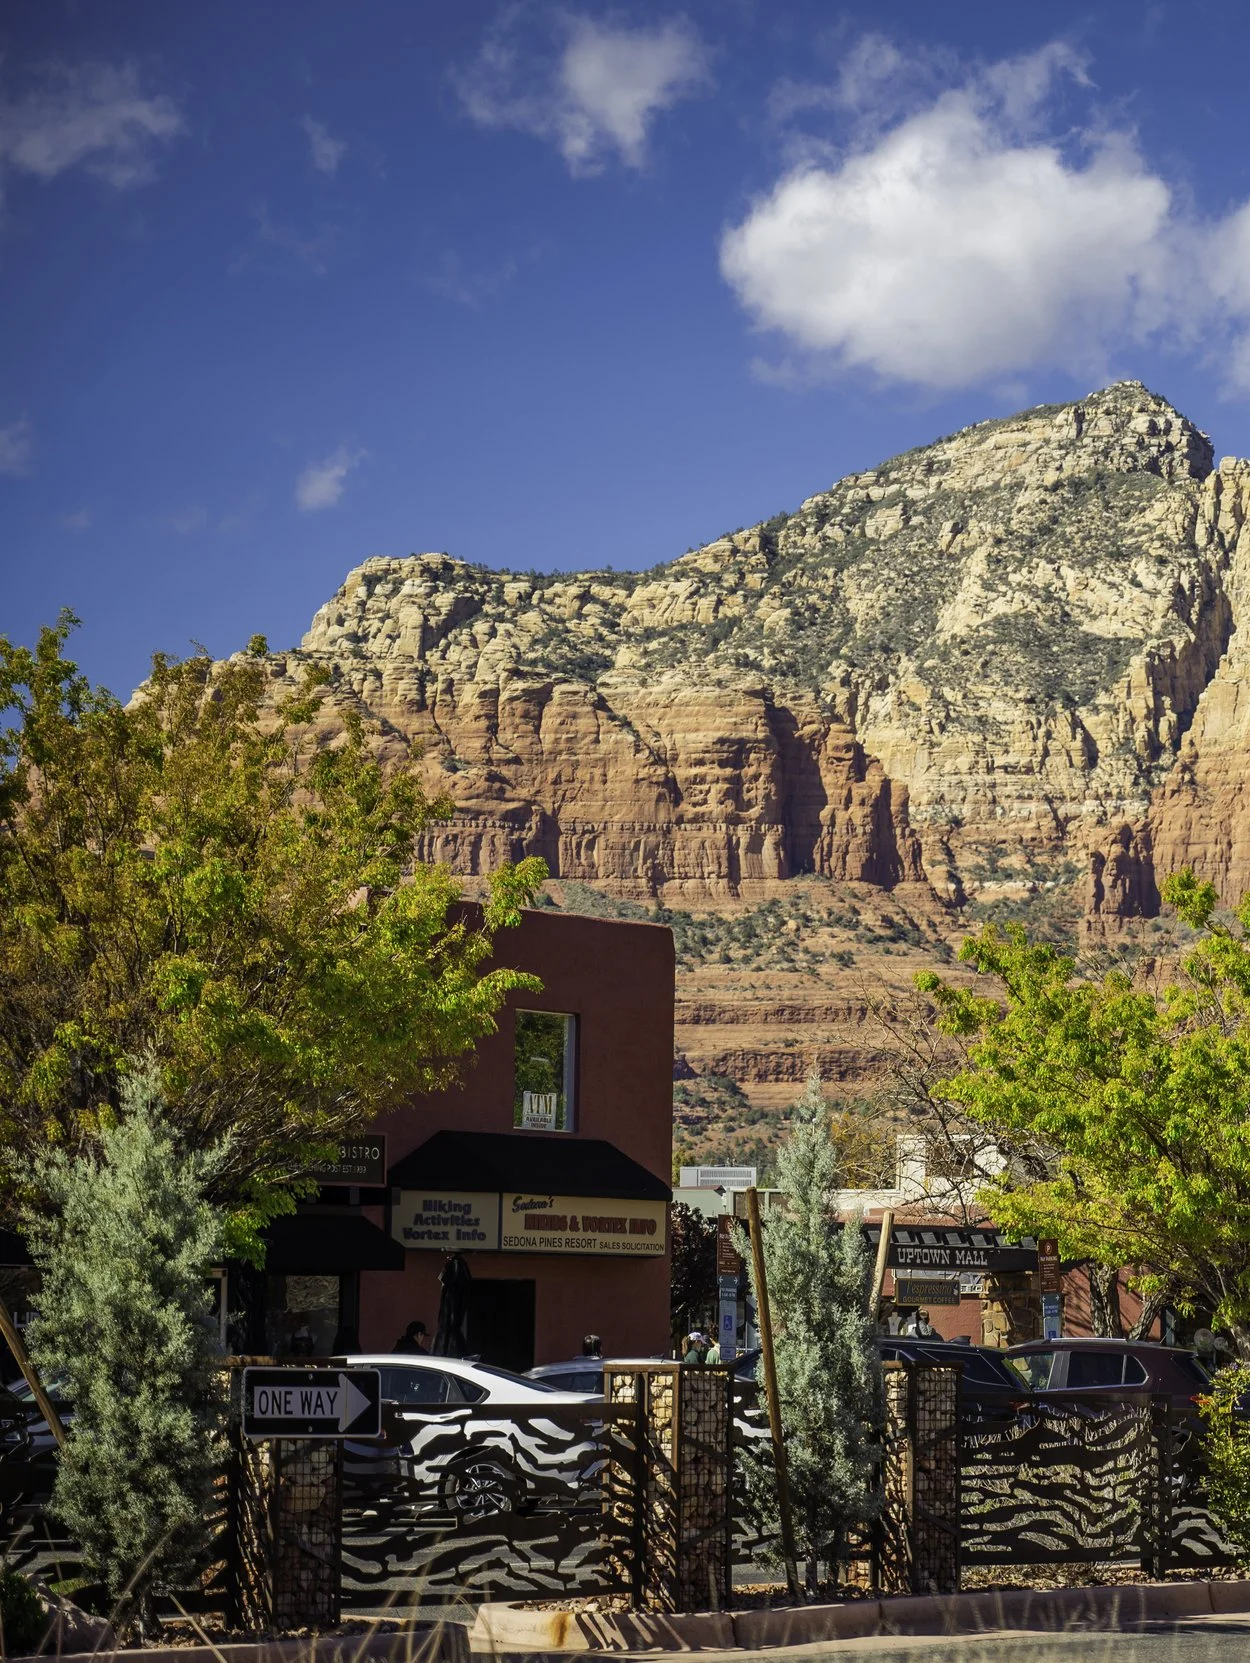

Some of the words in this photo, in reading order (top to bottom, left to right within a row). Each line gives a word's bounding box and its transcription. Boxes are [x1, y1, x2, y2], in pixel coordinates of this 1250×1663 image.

[524, 1091, 556, 1114] ATM
[340, 1145, 380, 1160] BISTRO
[422, 1199, 472, 1215] Hiking
[413, 1212, 480, 1227] Activities
[524, 1213, 568, 1231] HIKING
[568, 1214, 580, 1233] &
[581, 1215, 627, 1234] VORTEX
[628, 1217, 657, 1236] INFO
[402, 1227, 450, 1241] Vortex
[456, 1228, 487, 1242] Info
[503, 1235, 537, 1248] SEDONA
[539, 1237, 563, 1249] PINES
[564, 1238, 597, 1249] RESORT
[599, 1241, 620, 1250] SALES
[621, 1242, 664, 1252] SOLICITATION
[897, 1248, 950, 1265] UPTOWN
[955, 1250, 988, 1266] MALL
[258, 1390, 293, 1415] ONE
[300, 1391, 338, 1415] WAY
